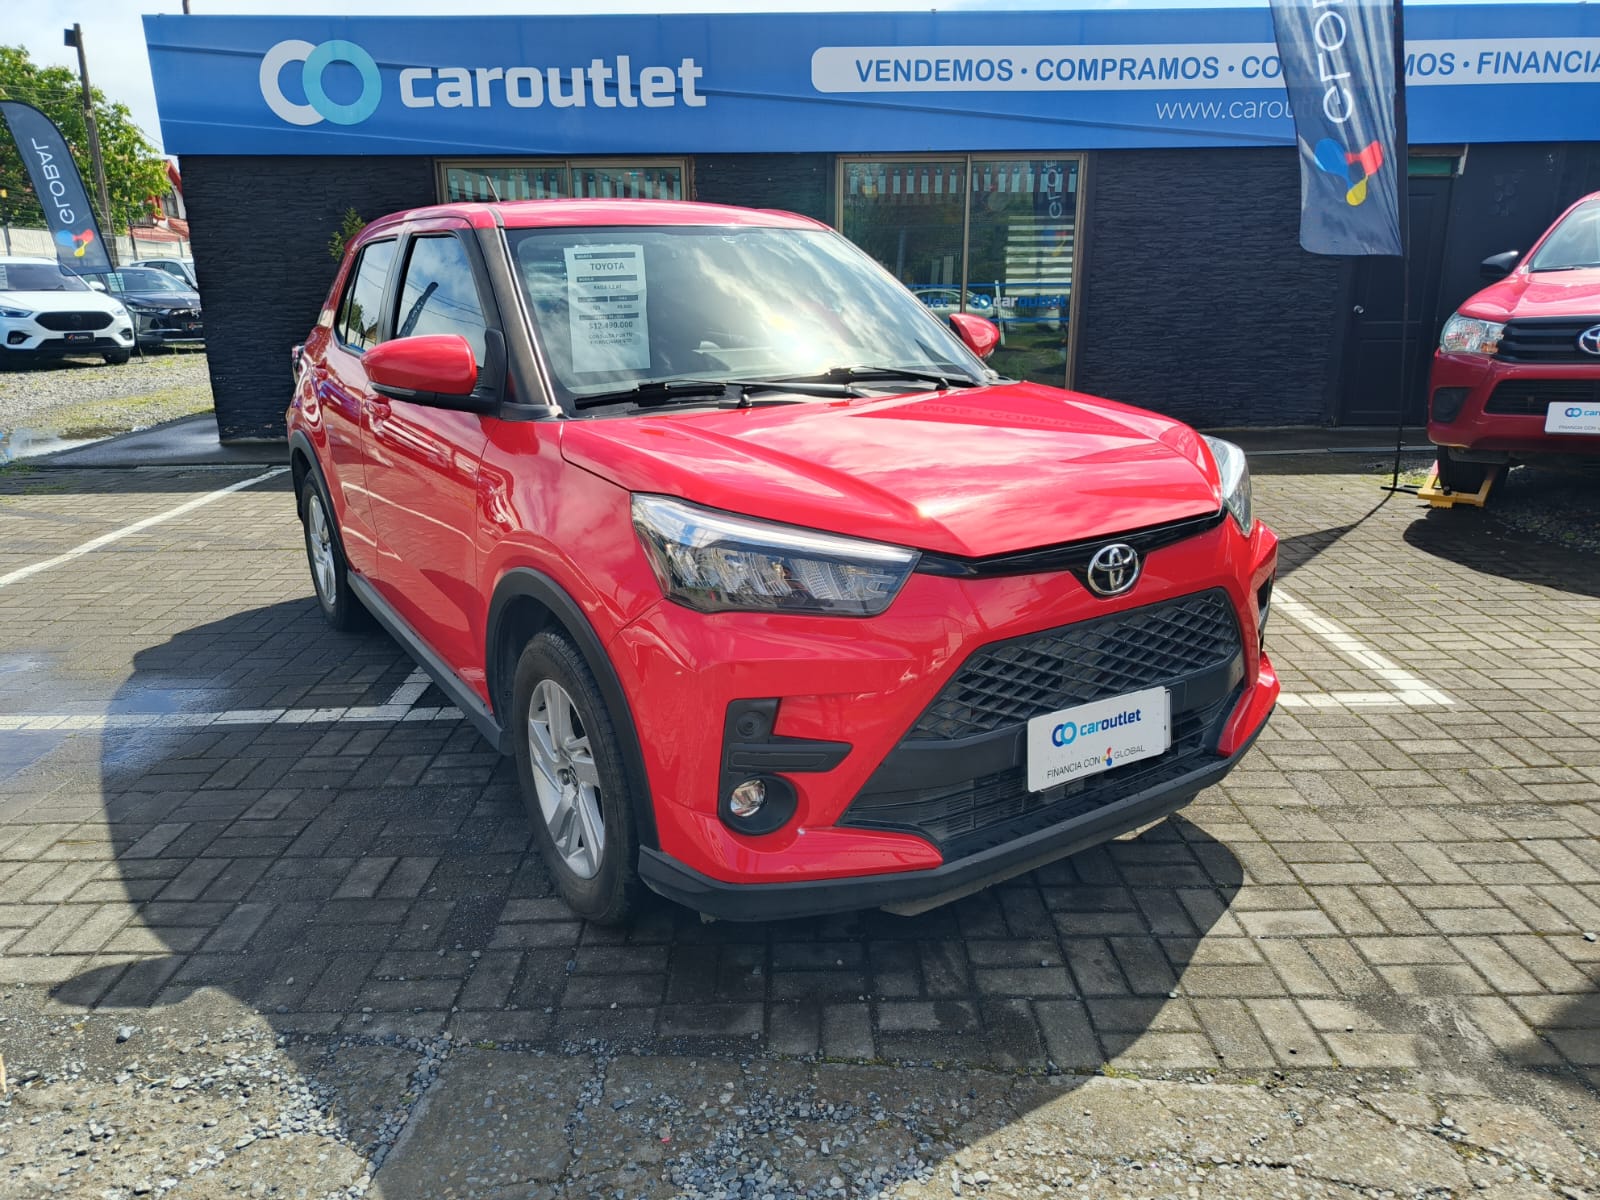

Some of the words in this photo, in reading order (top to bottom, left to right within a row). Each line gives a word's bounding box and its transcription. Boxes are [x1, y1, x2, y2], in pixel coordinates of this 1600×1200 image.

[399, 55, 707, 108] caroutlet
[855, 59, 1013, 82] VENDEMOS
[1035, 56, 1219, 81] COMPRAMOS
[590, 262, 625, 271] TOYOTA
[1080, 709, 1141, 736] caroutlet
[1047, 762, 1083, 779] FINANCIA
[1083, 755, 1101, 769] CON
[1114, 744, 1146, 760] GLOBAL
